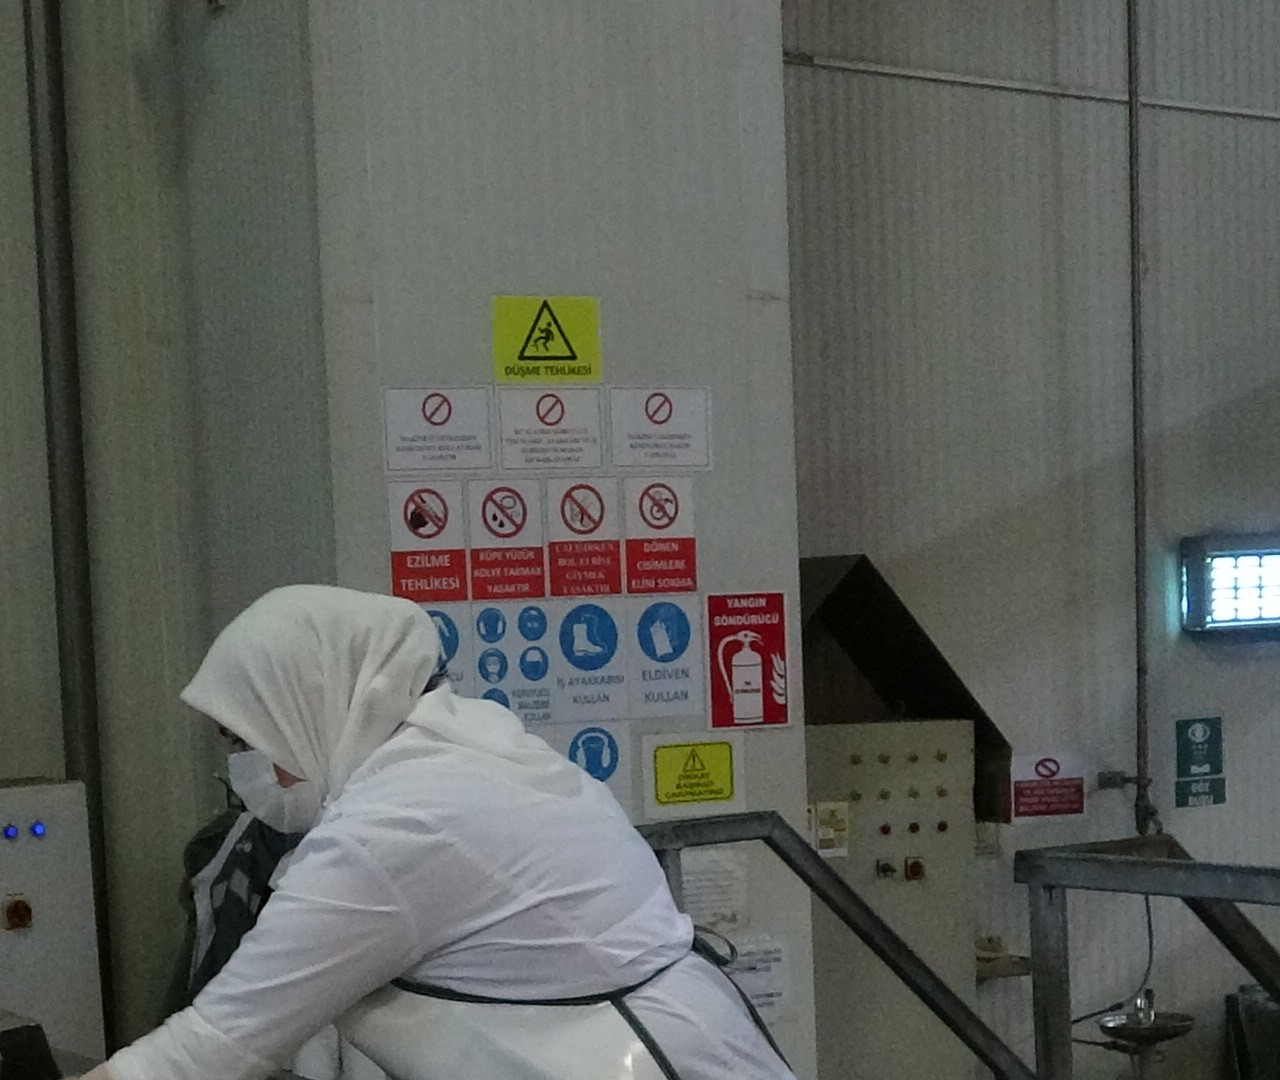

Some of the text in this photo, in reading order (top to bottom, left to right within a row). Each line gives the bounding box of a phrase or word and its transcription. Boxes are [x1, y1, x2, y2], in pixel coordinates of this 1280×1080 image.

[505, 365, 540, 377] DÜŞME
[406, 553, 451, 568] EZİLME
[400, 575, 460, 591] TEHLİKESİ
[727, 597, 766, 608] YANGIN
[714, 612, 779, 626] SÖNDÜRÜCÜ
[641, 668, 689, 681] ELDİVEN
[644, 690, 689, 703] KULLAN
